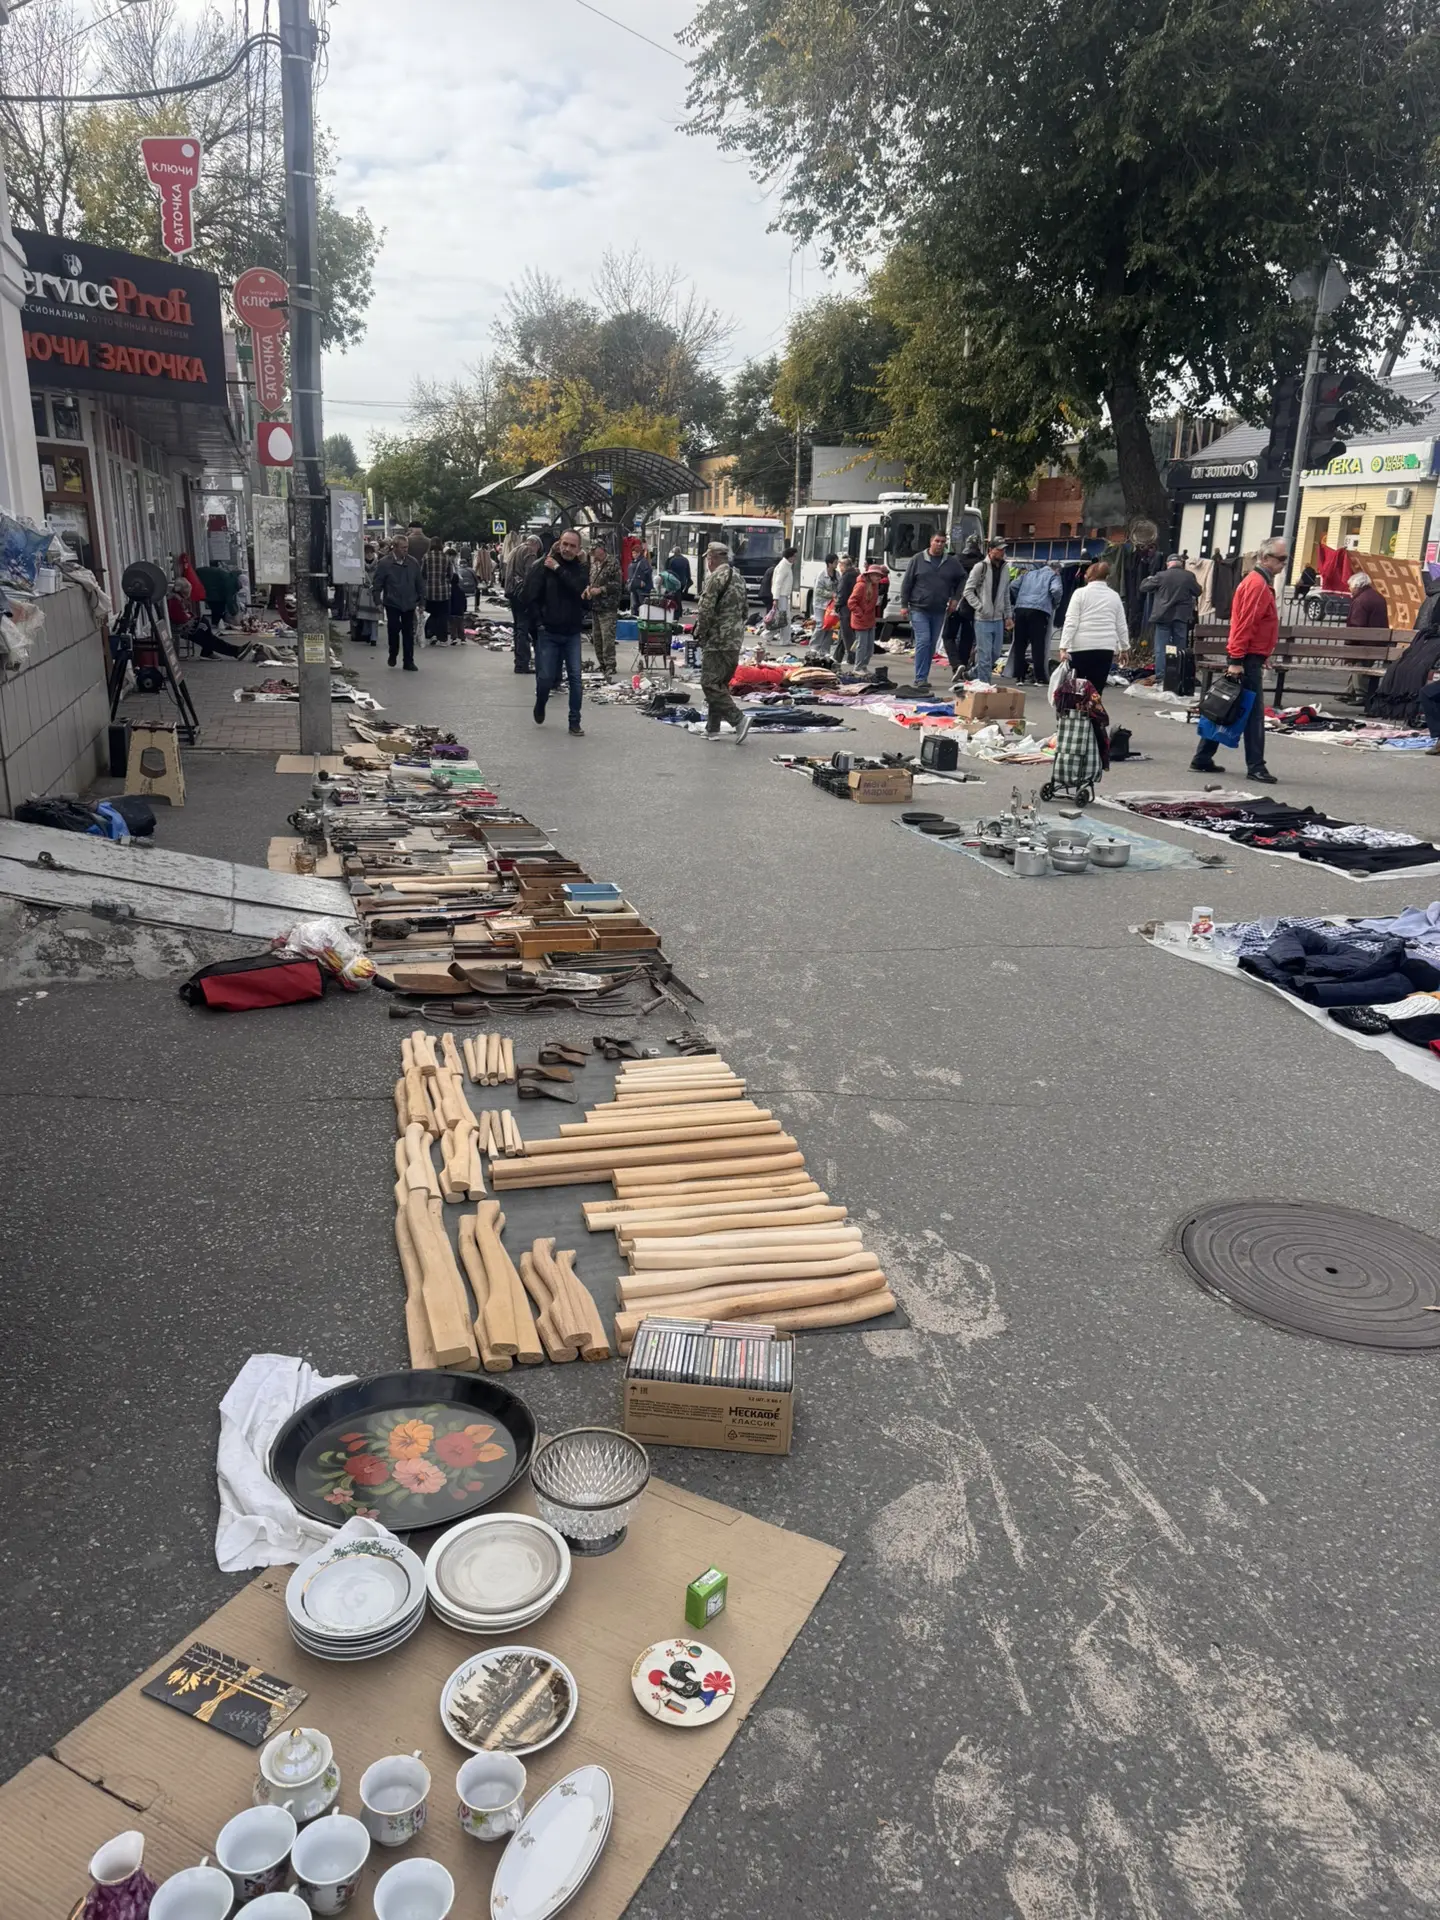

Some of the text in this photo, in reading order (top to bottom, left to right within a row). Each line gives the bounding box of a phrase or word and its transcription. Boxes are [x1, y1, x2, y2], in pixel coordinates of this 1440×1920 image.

[152, 162, 194, 177] КЛЮЧИ
[172, 183, 186, 246] ЗАТОЧКА
[22, 268, 195, 327] erviceProfi
[20, 303, 89, 323] ССИОНАЛИЗМ,
[22, 330, 208, 384] ЮЧИ ЗАТОЧКА
[261, 335, 278, 401] ЗАТОЧКА
[1205, 464, 1243, 478] ЗОЛОТО
[1212, 491, 1241, 499] ЮВЕЛИРНОЙ
[731, 1418, 776, 1427] КЛАССИК
